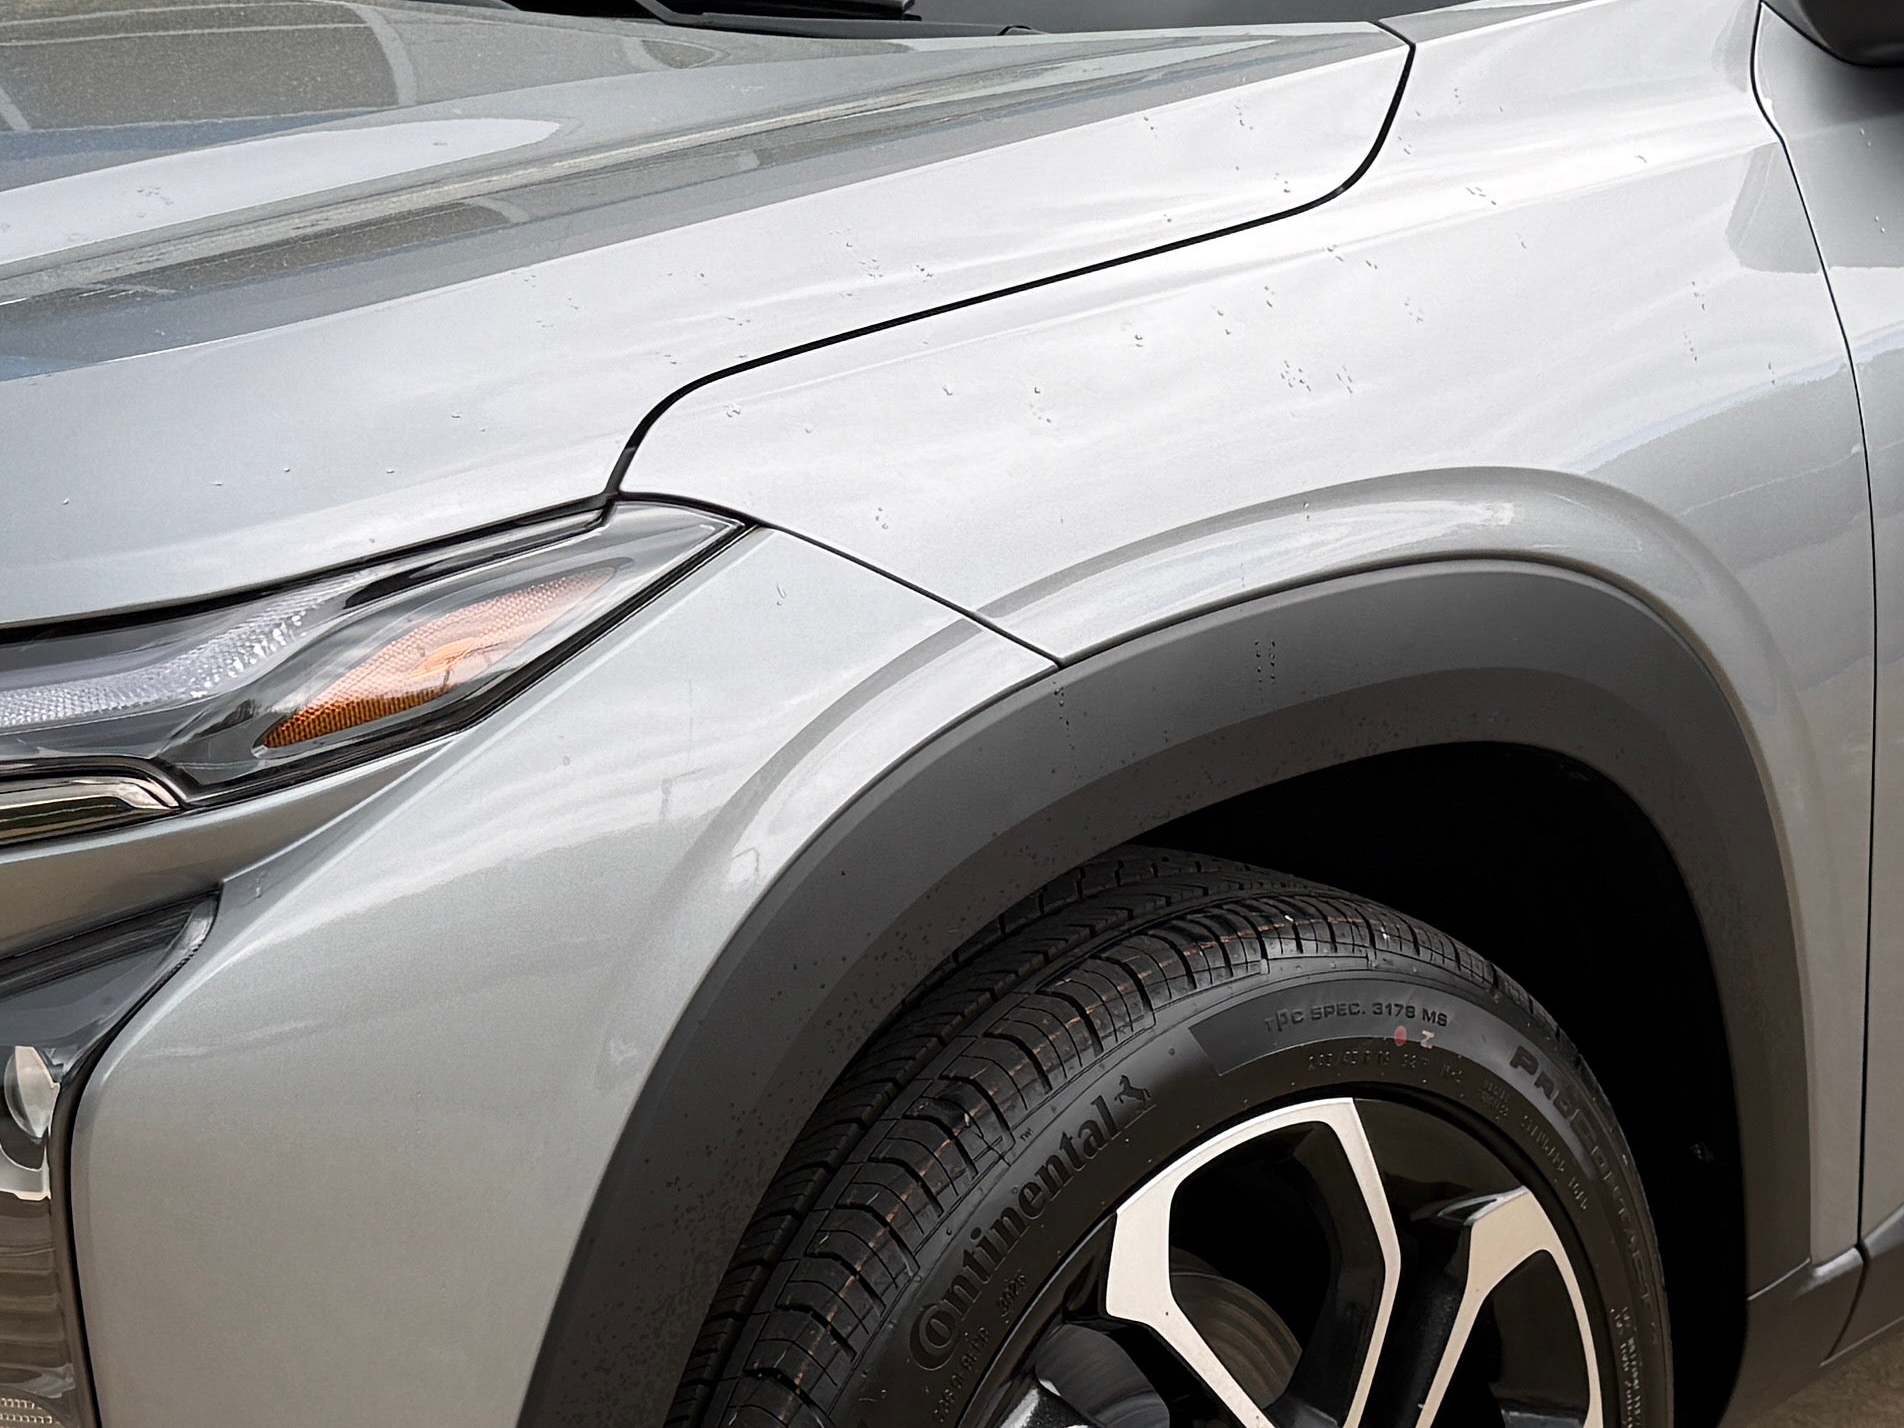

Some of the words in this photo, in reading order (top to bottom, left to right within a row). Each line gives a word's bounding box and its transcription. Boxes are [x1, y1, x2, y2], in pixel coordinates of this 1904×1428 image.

[1310, 1002, 1367, 1022] SPEC.
[1422, 1007, 1449, 1027] MS
[909, 1094, 1118, 1372] Continental
